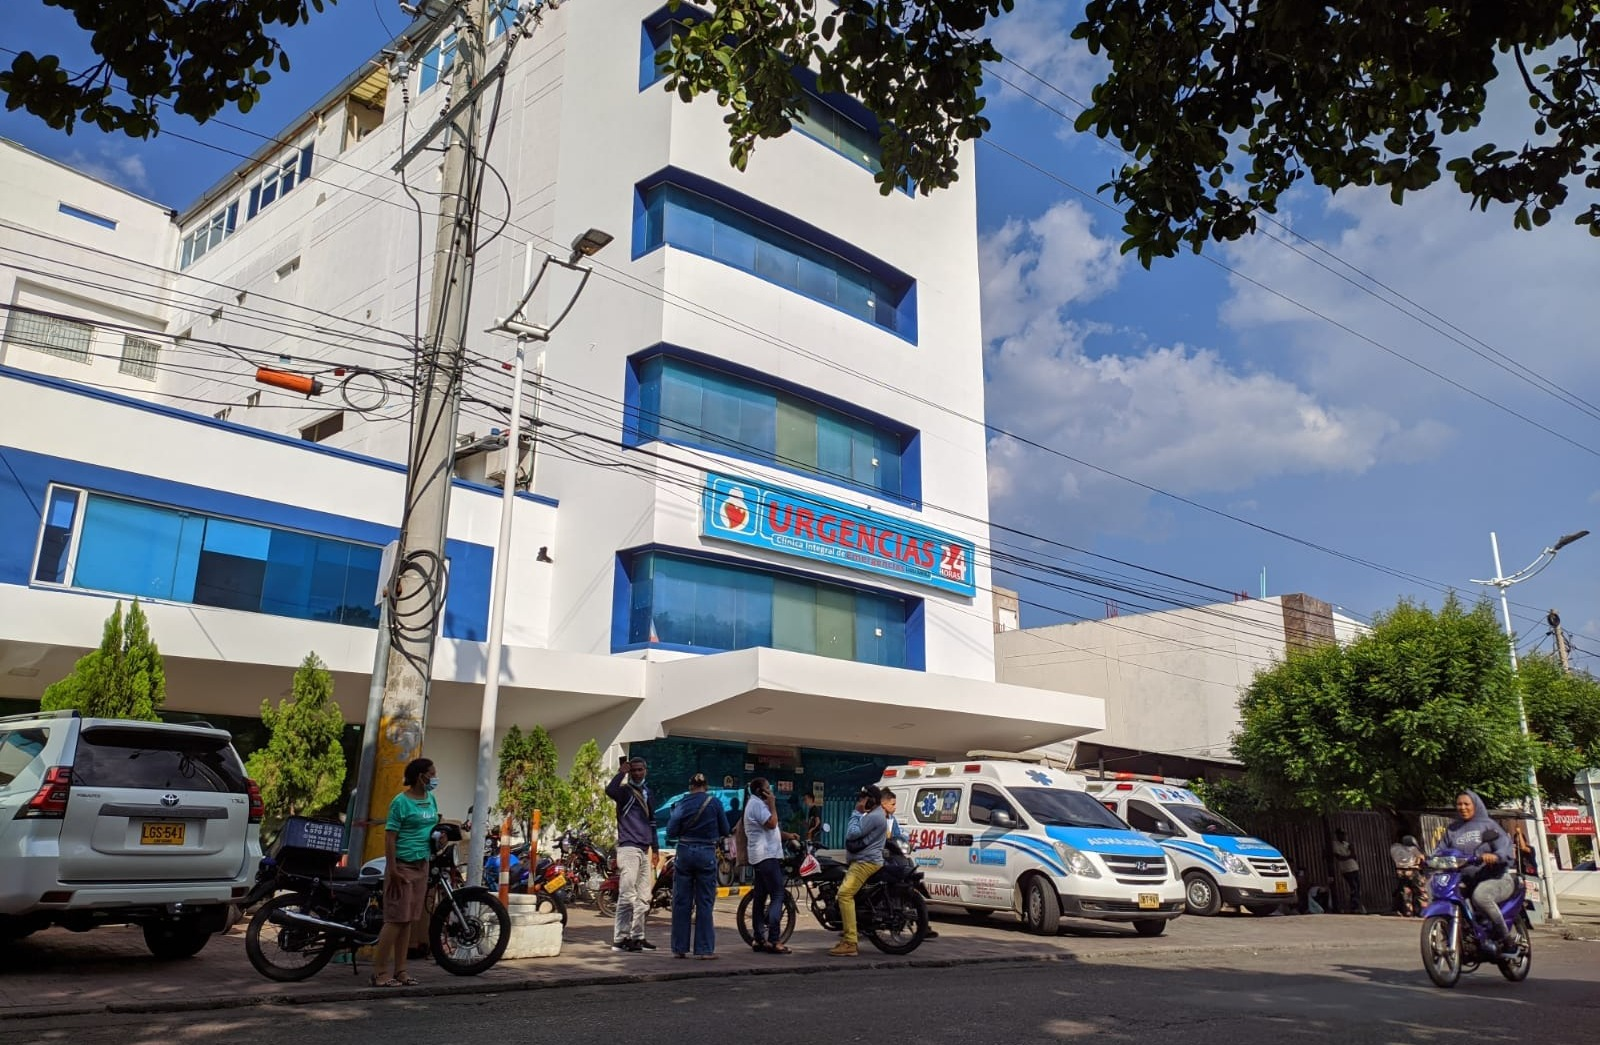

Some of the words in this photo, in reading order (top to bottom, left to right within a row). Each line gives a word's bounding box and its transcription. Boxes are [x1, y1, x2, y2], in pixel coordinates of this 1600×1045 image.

[768, 501, 935, 569] URGENCIAS
[805, 542, 835, 556] Integral
[836, 549, 846, 558] de
[940, 544, 966, 581] 24
[939, 569, 961, 580] HORAS
